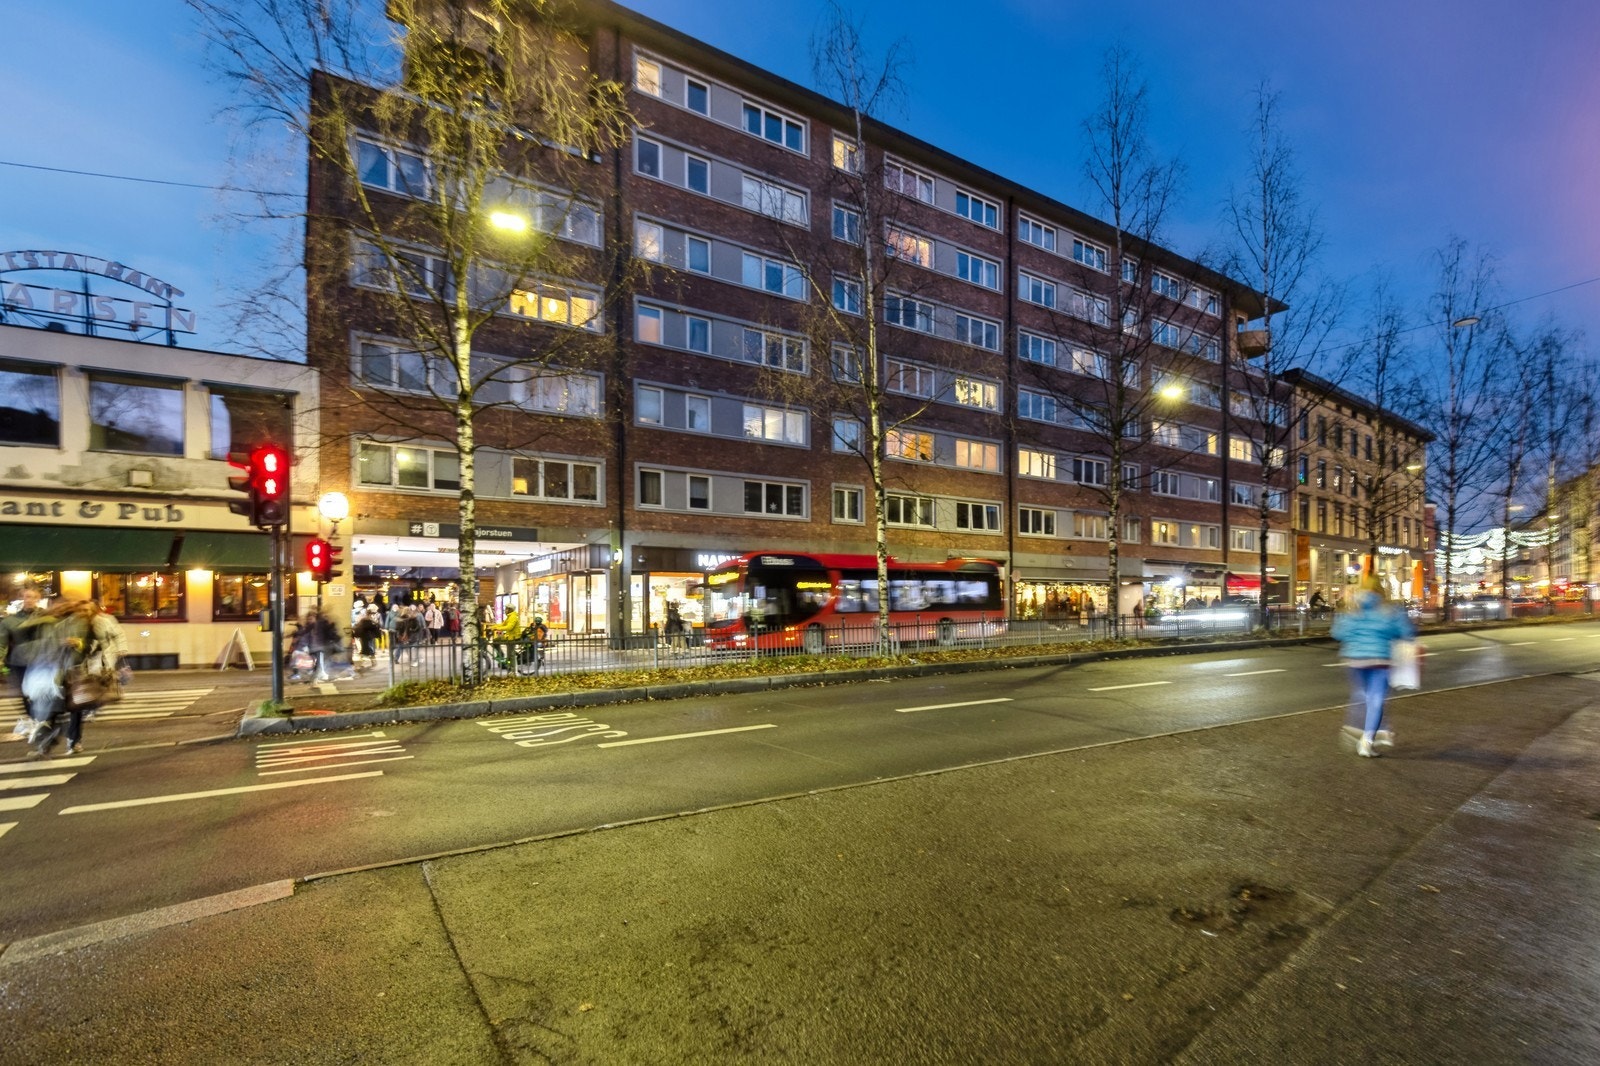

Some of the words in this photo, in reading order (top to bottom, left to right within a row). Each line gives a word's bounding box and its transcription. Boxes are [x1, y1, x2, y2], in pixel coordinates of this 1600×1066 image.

[78, 501, 104, 518] &
[117, 503, 185, 522] Pub
[475, 712, 628, 748] BUSS
[255, 731, 414, 777] TAXI
